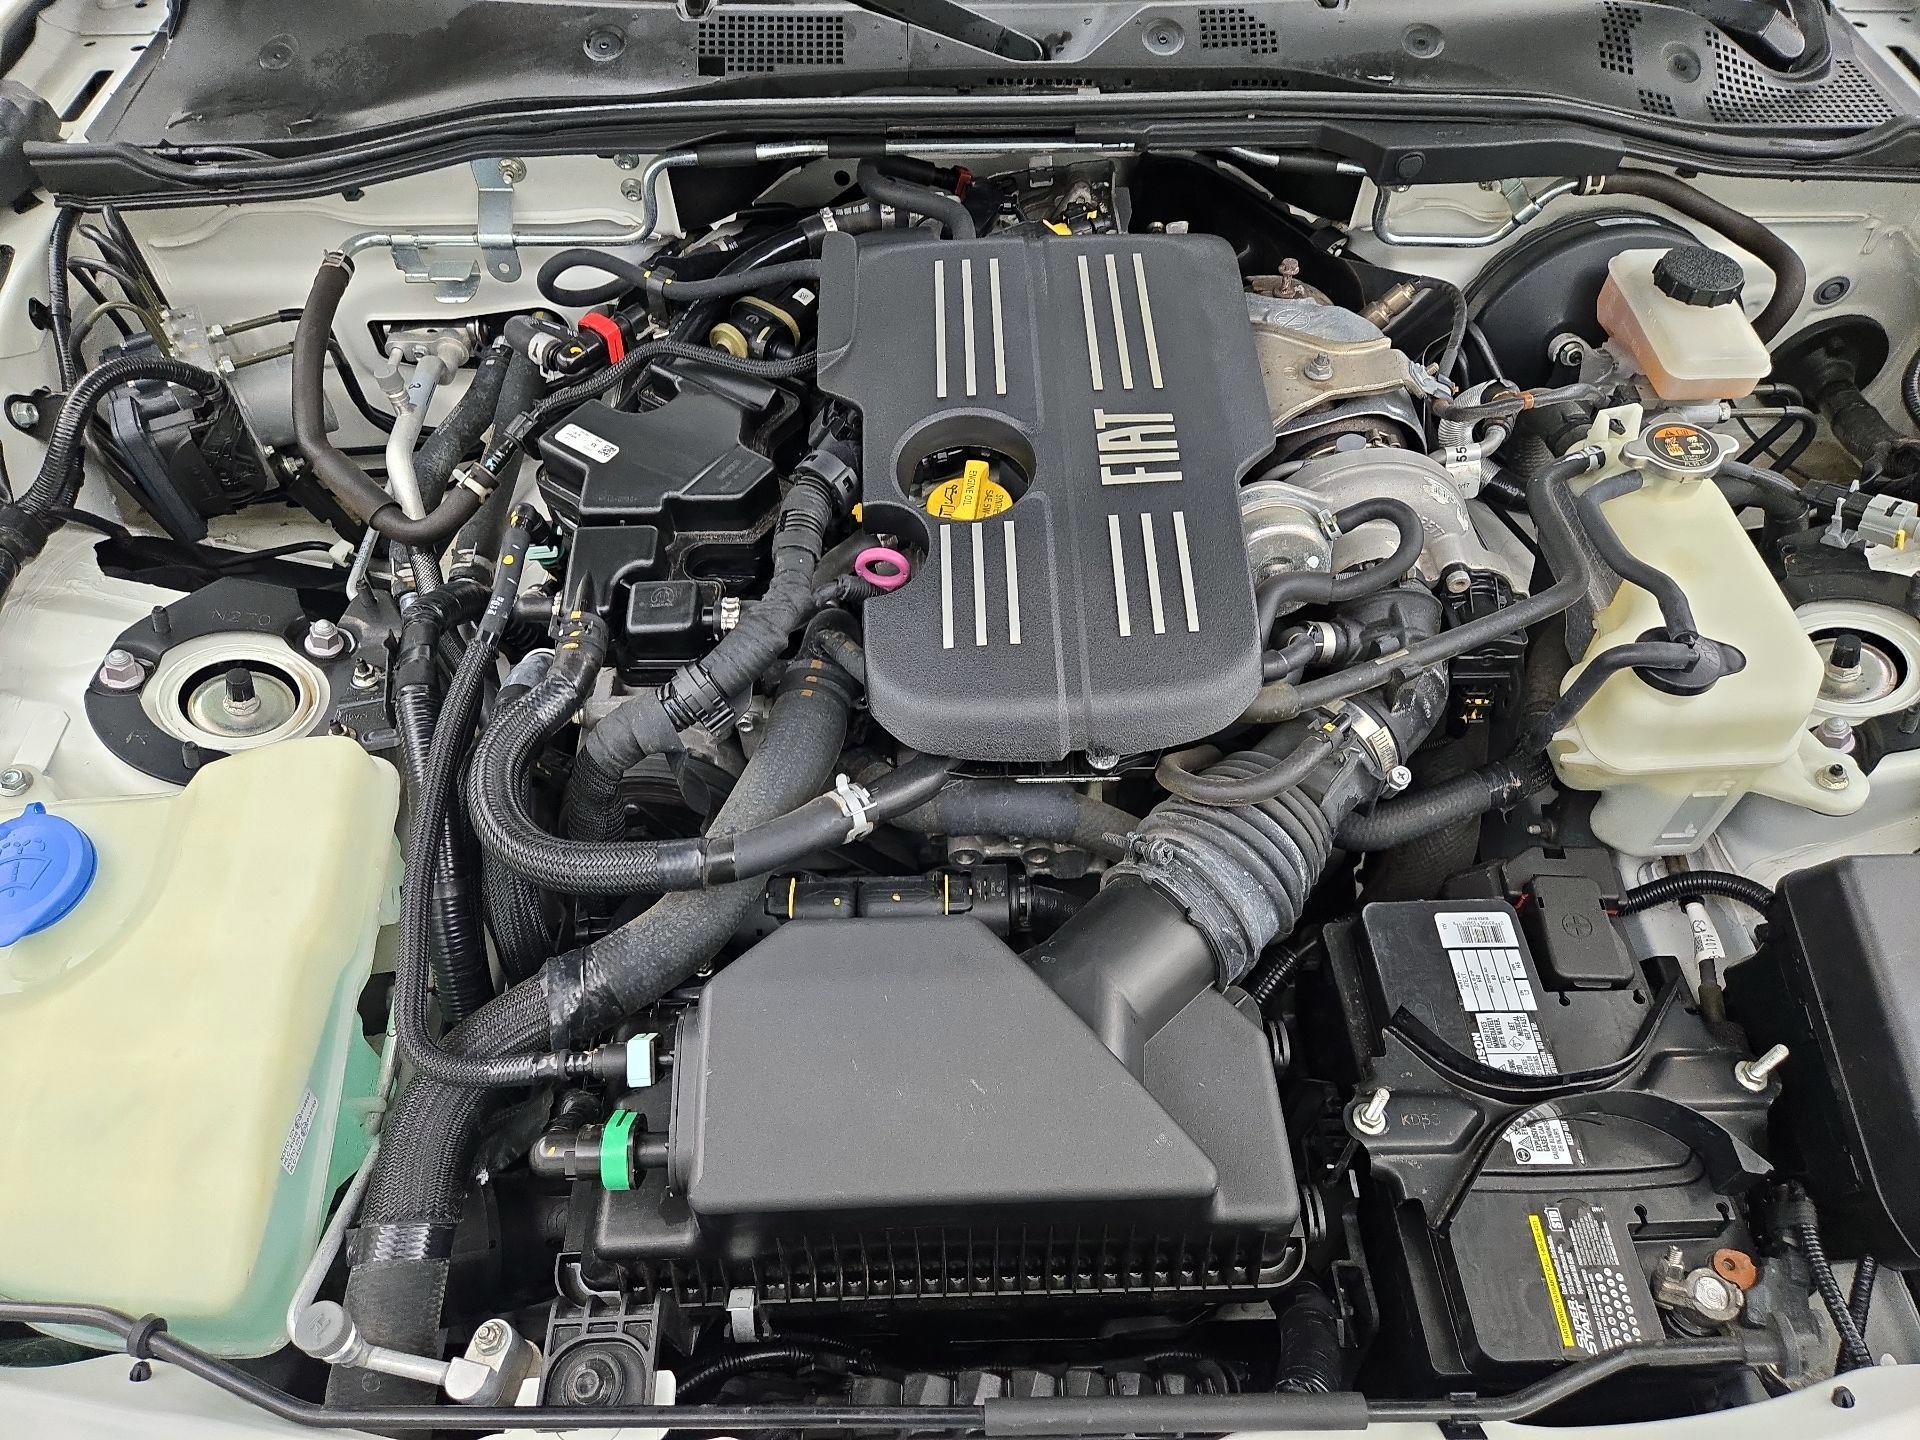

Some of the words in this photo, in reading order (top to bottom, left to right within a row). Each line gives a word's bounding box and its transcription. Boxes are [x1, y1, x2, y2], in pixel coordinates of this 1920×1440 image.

[1094, 409, 1182, 485] FIAT
[966, 470, 977, 494] ENGINE
[962, 495, 972, 506] OIL
[984, 489, 994, 502] SAE
[1480, 1021, 1488, 1032] EYES
[1512, 1016, 1523, 1036] MEDICAL
[1519, 1014, 1527, 1027] FAST.
[1486, 1017, 1500, 1048] IMMEDIATELY
[1523, 1028, 1531, 1040] HELP
[1484, 1034, 1493, 1047] FLUSH
[1560, 1120, 1569, 1130] OUT
[1564, 1132, 1573, 1145] KEEP
[1550, 1144, 1559, 1159] CAUSE
[1546, 1273, 1559, 1302] WARRANTY
[1555, 1303, 1570, 1338] NATIONWIDE
[1567, 1300, 1588, 1348] SUPER
[1576, 1302, 1598, 1355] START
